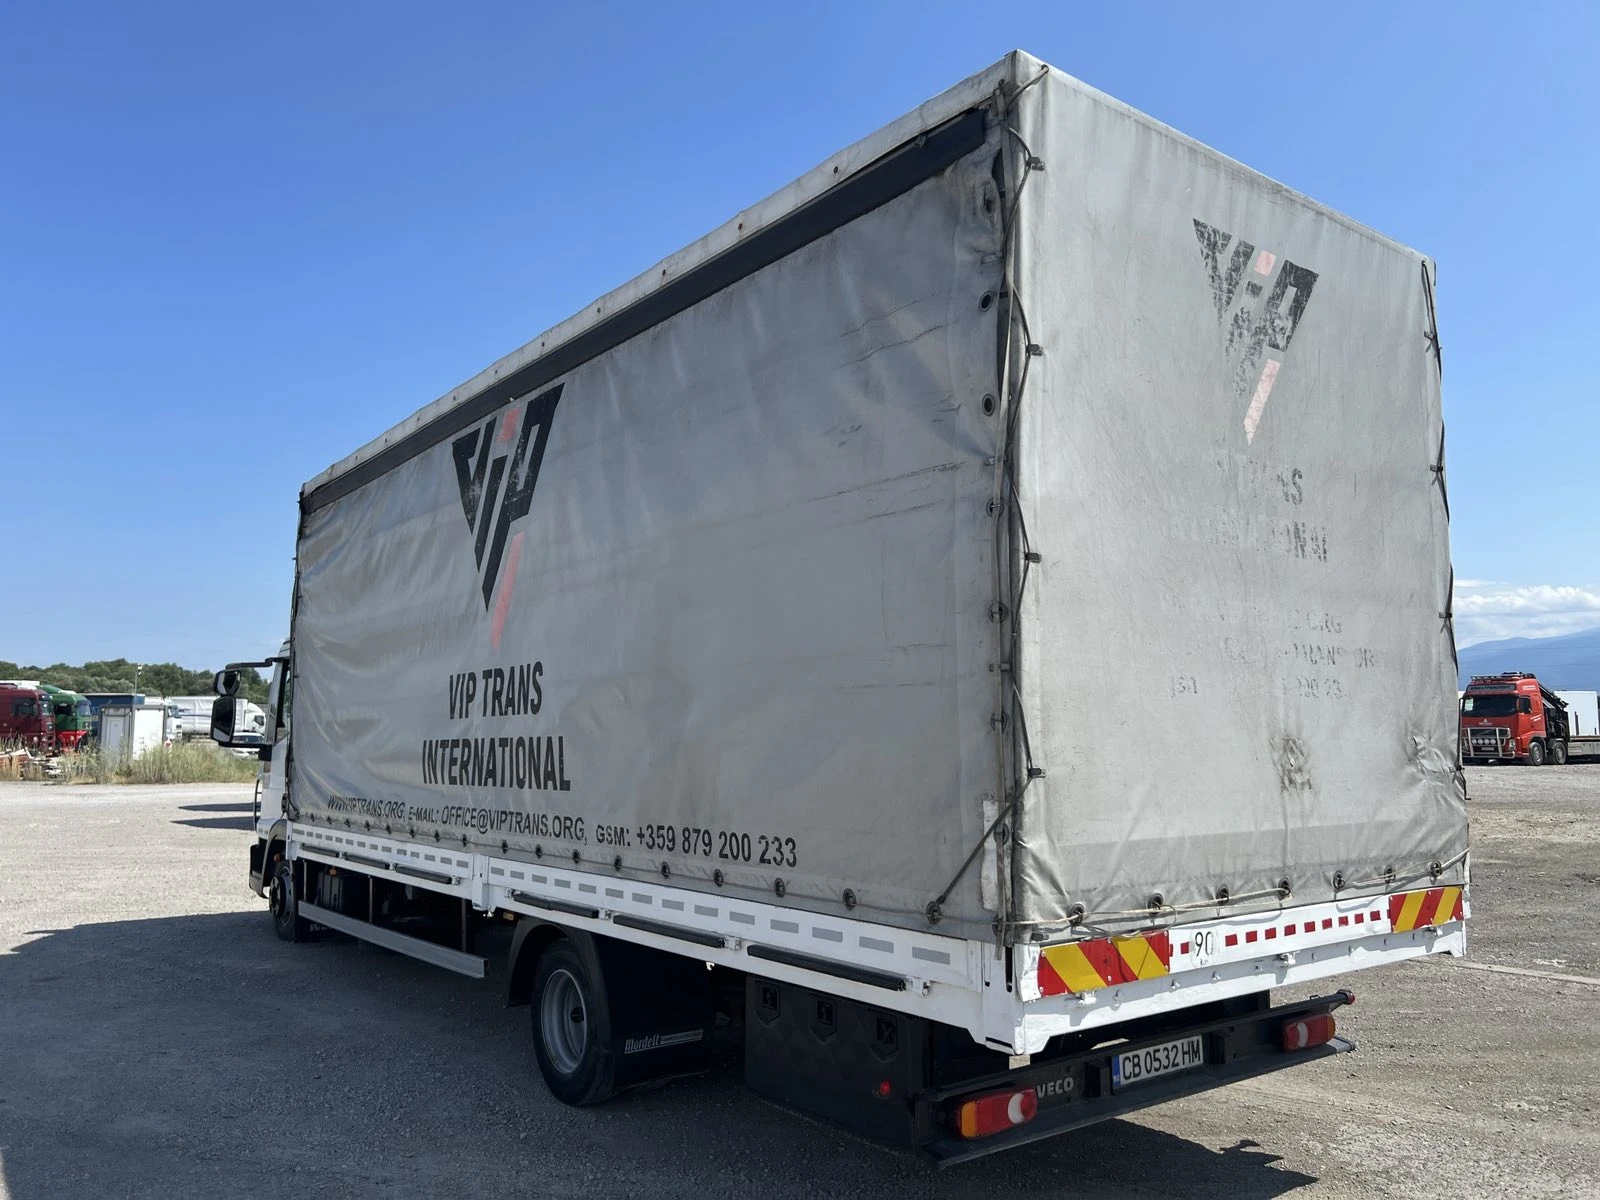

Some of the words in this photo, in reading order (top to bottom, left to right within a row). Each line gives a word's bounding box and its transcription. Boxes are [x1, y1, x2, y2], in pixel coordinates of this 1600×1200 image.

[450, 672, 476, 719] VIP
[482, 661, 543, 717] TRANS
[422, 736, 571, 791] INTERNATIONAL
[408, 806, 440, 824] E-MAIL:
[441, 805, 588, 846] OFFICE@VIPTRANS.ORG,
[596, 824, 631, 846] GSM:
[637, 824, 675, 852] +359
[682, 827, 712, 856] 879
[719, 831, 751, 862] 200
[758, 835, 797, 867] 233
[1195, 931, 1214, 957] 90
[1122, 1053, 1142, 1080] CB
[1144, 1044, 1180, 1074] 0532
[1181, 1039, 1201, 1066] HM
[1036, 1076, 1074, 1098] VECO
